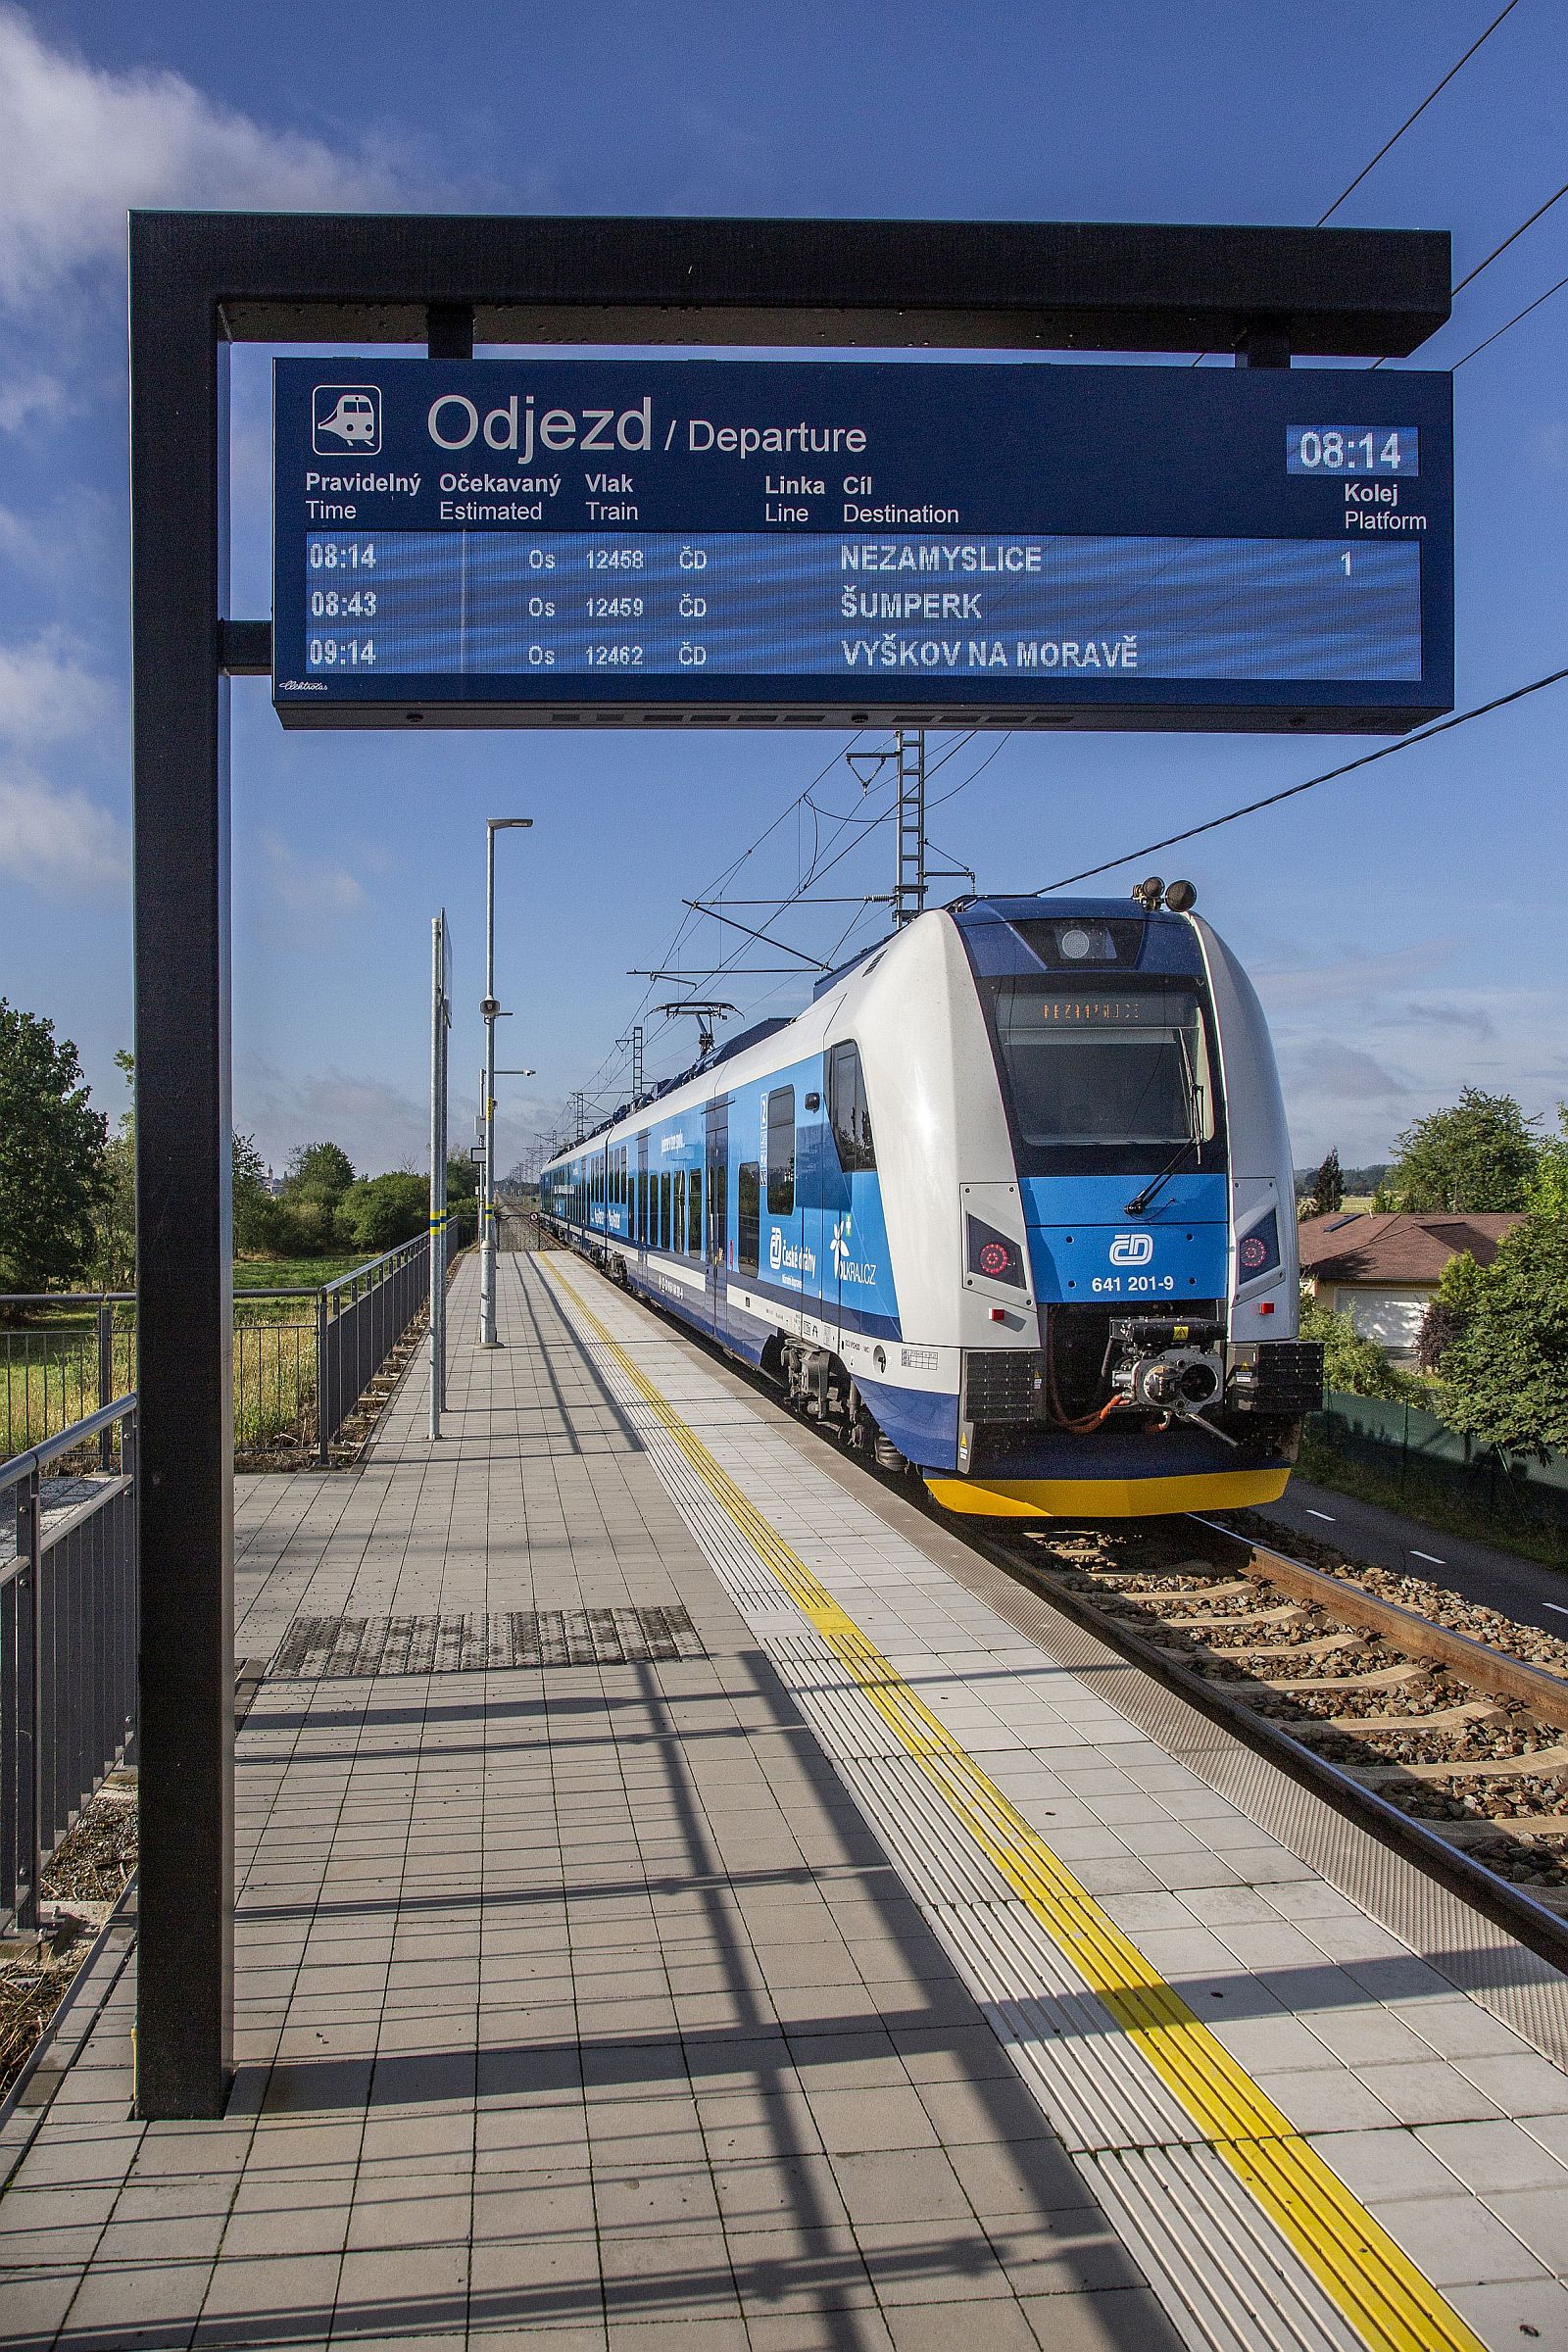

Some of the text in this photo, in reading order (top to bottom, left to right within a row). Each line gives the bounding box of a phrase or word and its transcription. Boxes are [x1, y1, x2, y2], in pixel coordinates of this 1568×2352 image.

[428, 395, 652, 464] Odjezd
[689, 419, 867, 459] Departure
[1299, 431, 1401, 468] 08:14
[306, 472, 421, 496] Pravidelný
[439, 473, 561, 498] Očekavaný
[585, 474, 634, 493] Vlak
[765, 476, 826, 495] Linka
[843, 475, 872, 495] Cíl
[1345, 484, 1398, 507] Kolej
[306, 501, 357, 519] Time
[440, 502, 542, 520] Estimated
[585, 502, 639, 520] Train
[765, 504, 809, 522] Line
[843, 504, 959, 523] Destination
[1345, 512, 1427, 530] Platform
[310, 543, 1352, 576] 08:14 Os 12458 ČD NEZAMYSLICE 1
[311, 586, 983, 618] 08:43 Os 12459 ČD ŠUMPERK
[310, 633, 1138, 667] 09:14 Os 12462 ČD VYŠKOV NA MORAVĚ
[1092, 1276, 1174, 1292] 641 201-9
